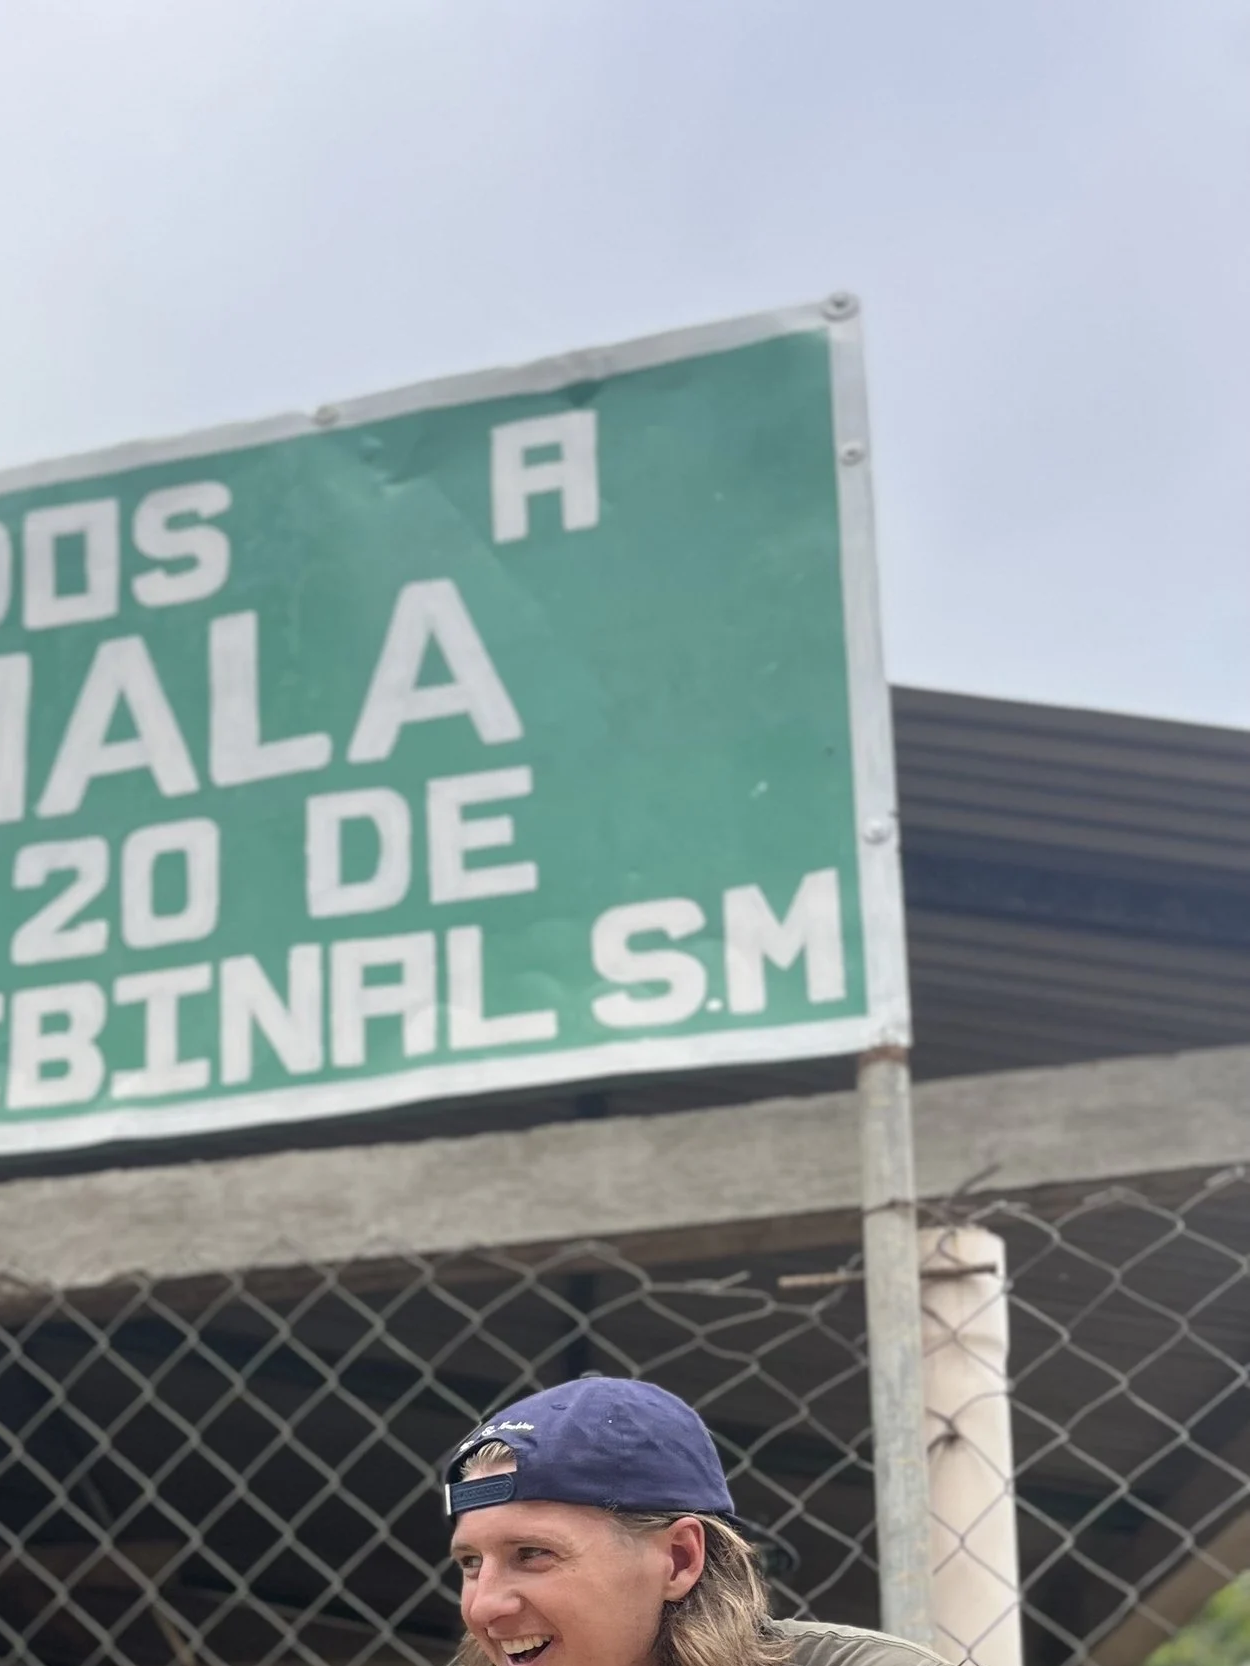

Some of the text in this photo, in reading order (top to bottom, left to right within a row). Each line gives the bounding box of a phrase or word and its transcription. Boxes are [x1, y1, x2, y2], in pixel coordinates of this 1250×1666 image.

[489, 408, 602, 544] A
[10, 816, 221, 967] 20
[304, 765, 539, 919] DE
